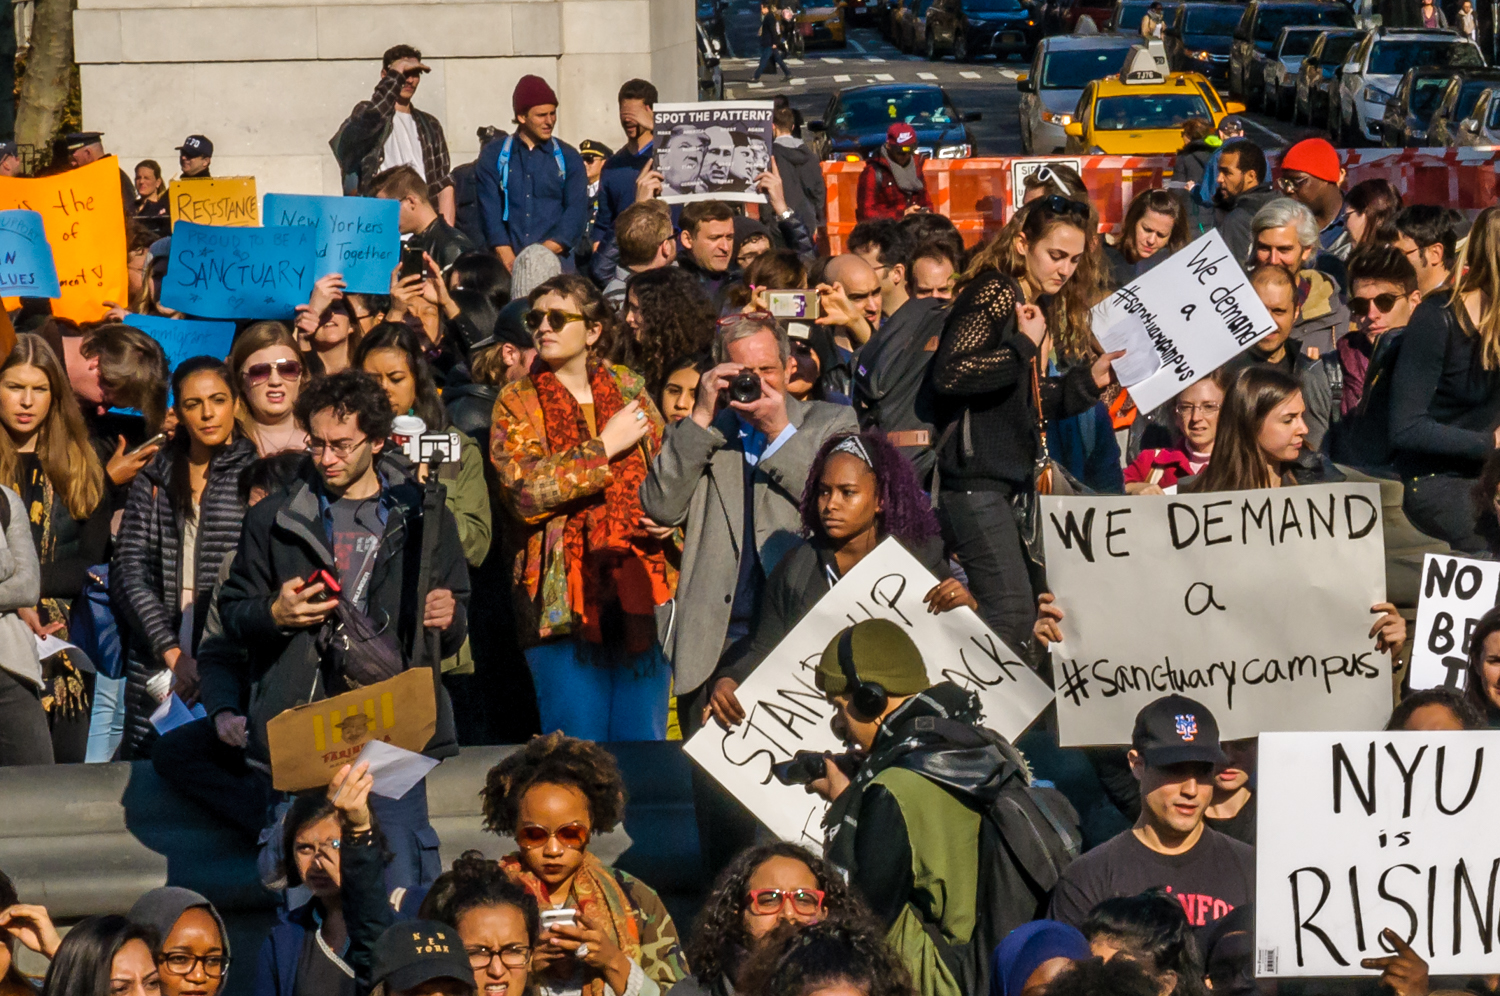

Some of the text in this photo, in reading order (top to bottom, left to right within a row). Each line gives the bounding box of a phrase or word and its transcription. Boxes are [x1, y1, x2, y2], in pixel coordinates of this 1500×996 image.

[655, 109, 773, 124] SPOT THE PATTERN?
[53, 189, 95, 216] the
[177, 193, 257, 222] RESISTANCE
[62, 222, 79, 242] of
[281, 210, 384, 235] New Yorkers
[187, 230, 308, 248] PROUD TO BE A
[336, 242, 394, 268] Together
[177, 250, 305, 292] SANCTUARY
[1186, 240, 1272, 347] We demand
[1180, 303, 1197, 321] a
[1050, 493, 1378, 563] WE DEMAND
[1424, 557, 1483, 600] NO
[1185, 582, 1226, 616] a
[1331, 740, 1485, 819] NYU
[1378, 829, 1412, 849] is
[415, 944, 450, 954] YORK
